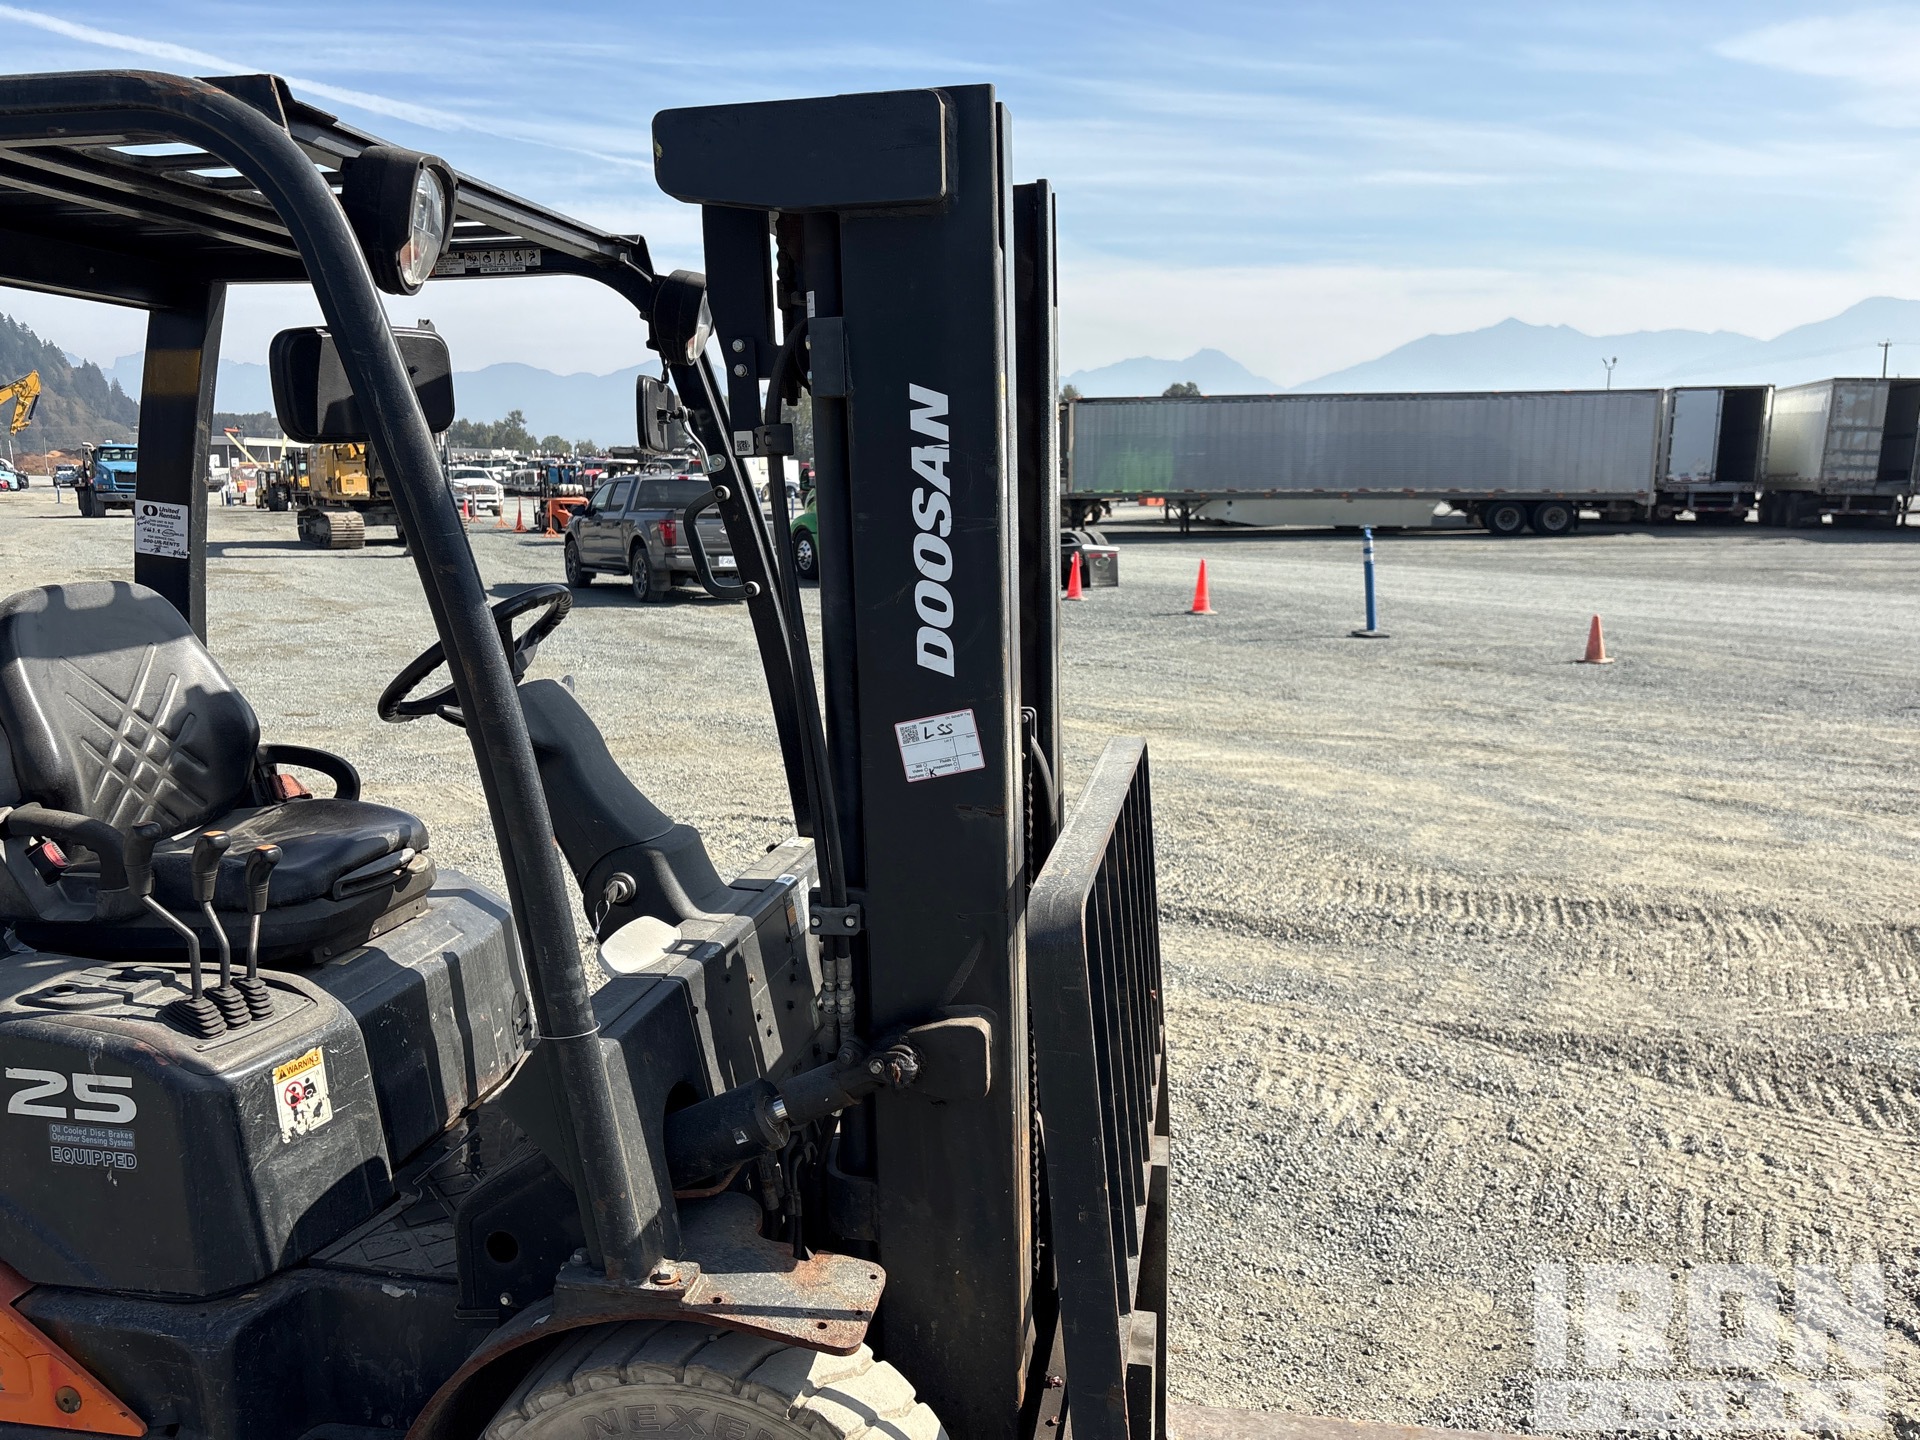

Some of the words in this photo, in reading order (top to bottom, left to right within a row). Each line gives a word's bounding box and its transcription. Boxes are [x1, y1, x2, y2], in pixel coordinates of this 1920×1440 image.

[158, 512, 181, 520] Rentals
[159, 506, 180, 514] United
[909, 382, 955, 678] DOOSAN
[5, 1066, 138, 1124] 25
[51, 1124, 61, 1133] Oil
[63, 1126, 87, 1136] Cooled
[89, 1128, 106, 1137] Disc
[108, 1130, 133, 1140] Brakes
[52, 1132, 80, 1143] Operator
[81, 1135, 108, 1147] Sensing
[108, 1138, 134, 1148] System
[50, 1146, 138, 1170] EQUIPPED
[582, 1403, 780, 1440] NEXE
